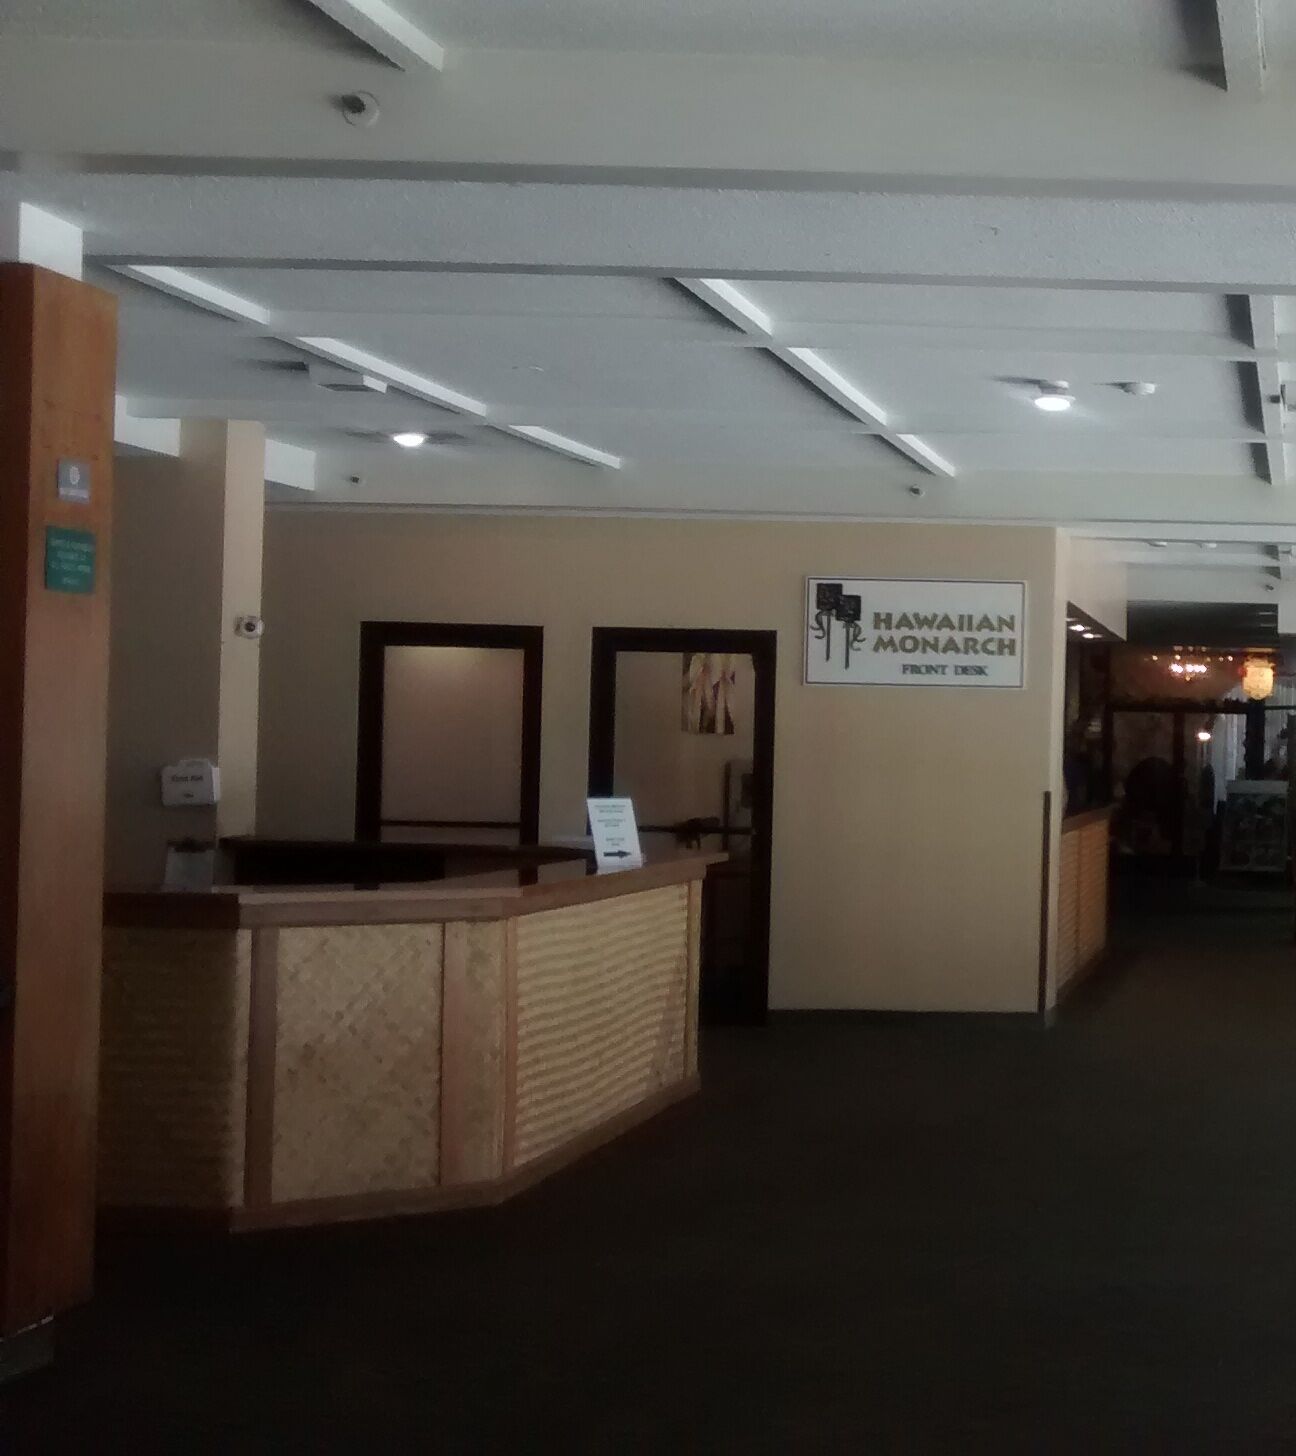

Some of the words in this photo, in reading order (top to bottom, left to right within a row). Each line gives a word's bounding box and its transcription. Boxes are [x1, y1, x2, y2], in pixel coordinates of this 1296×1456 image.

[872, 611, 1016, 632] HAWAIIAN
[872, 635, 1017, 656] MONARCH
[902, 664, 948, 675] FRONT
[954, 664, 989, 676] DESK
